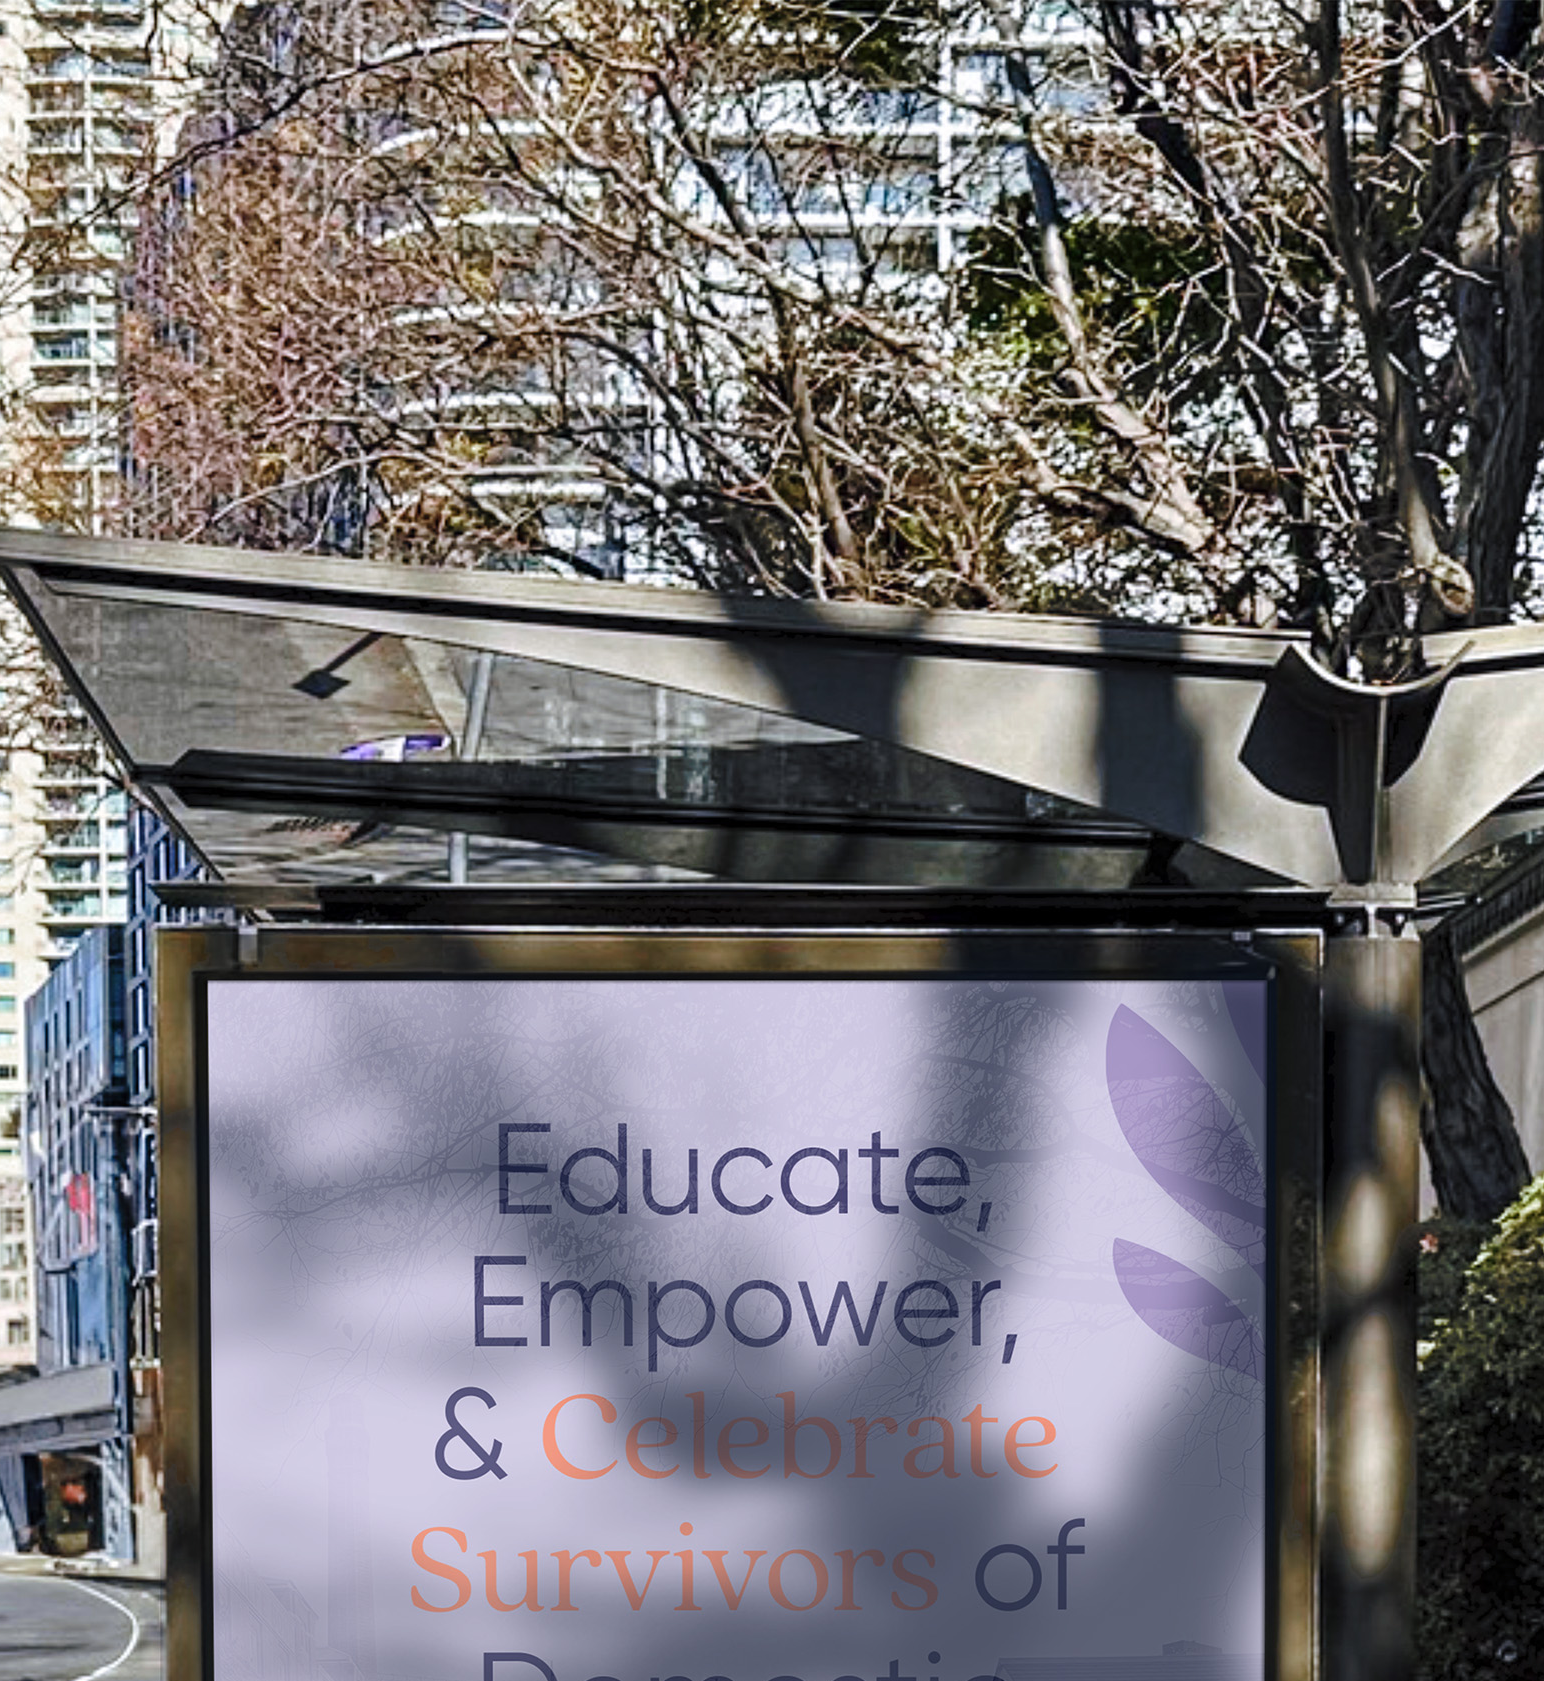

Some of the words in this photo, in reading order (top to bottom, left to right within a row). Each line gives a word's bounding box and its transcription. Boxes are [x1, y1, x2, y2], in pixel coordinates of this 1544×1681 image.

[496, 1122, 993, 1233] Educate,
[473, 1255, 1019, 1373] Empower,
[434, 1386, 509, 1481] &
[542, 1391, 1059, 1481] Celebrate
[409, 1521, 939, 1613] Survivors
[973, 1517, 1087, 1612] of
